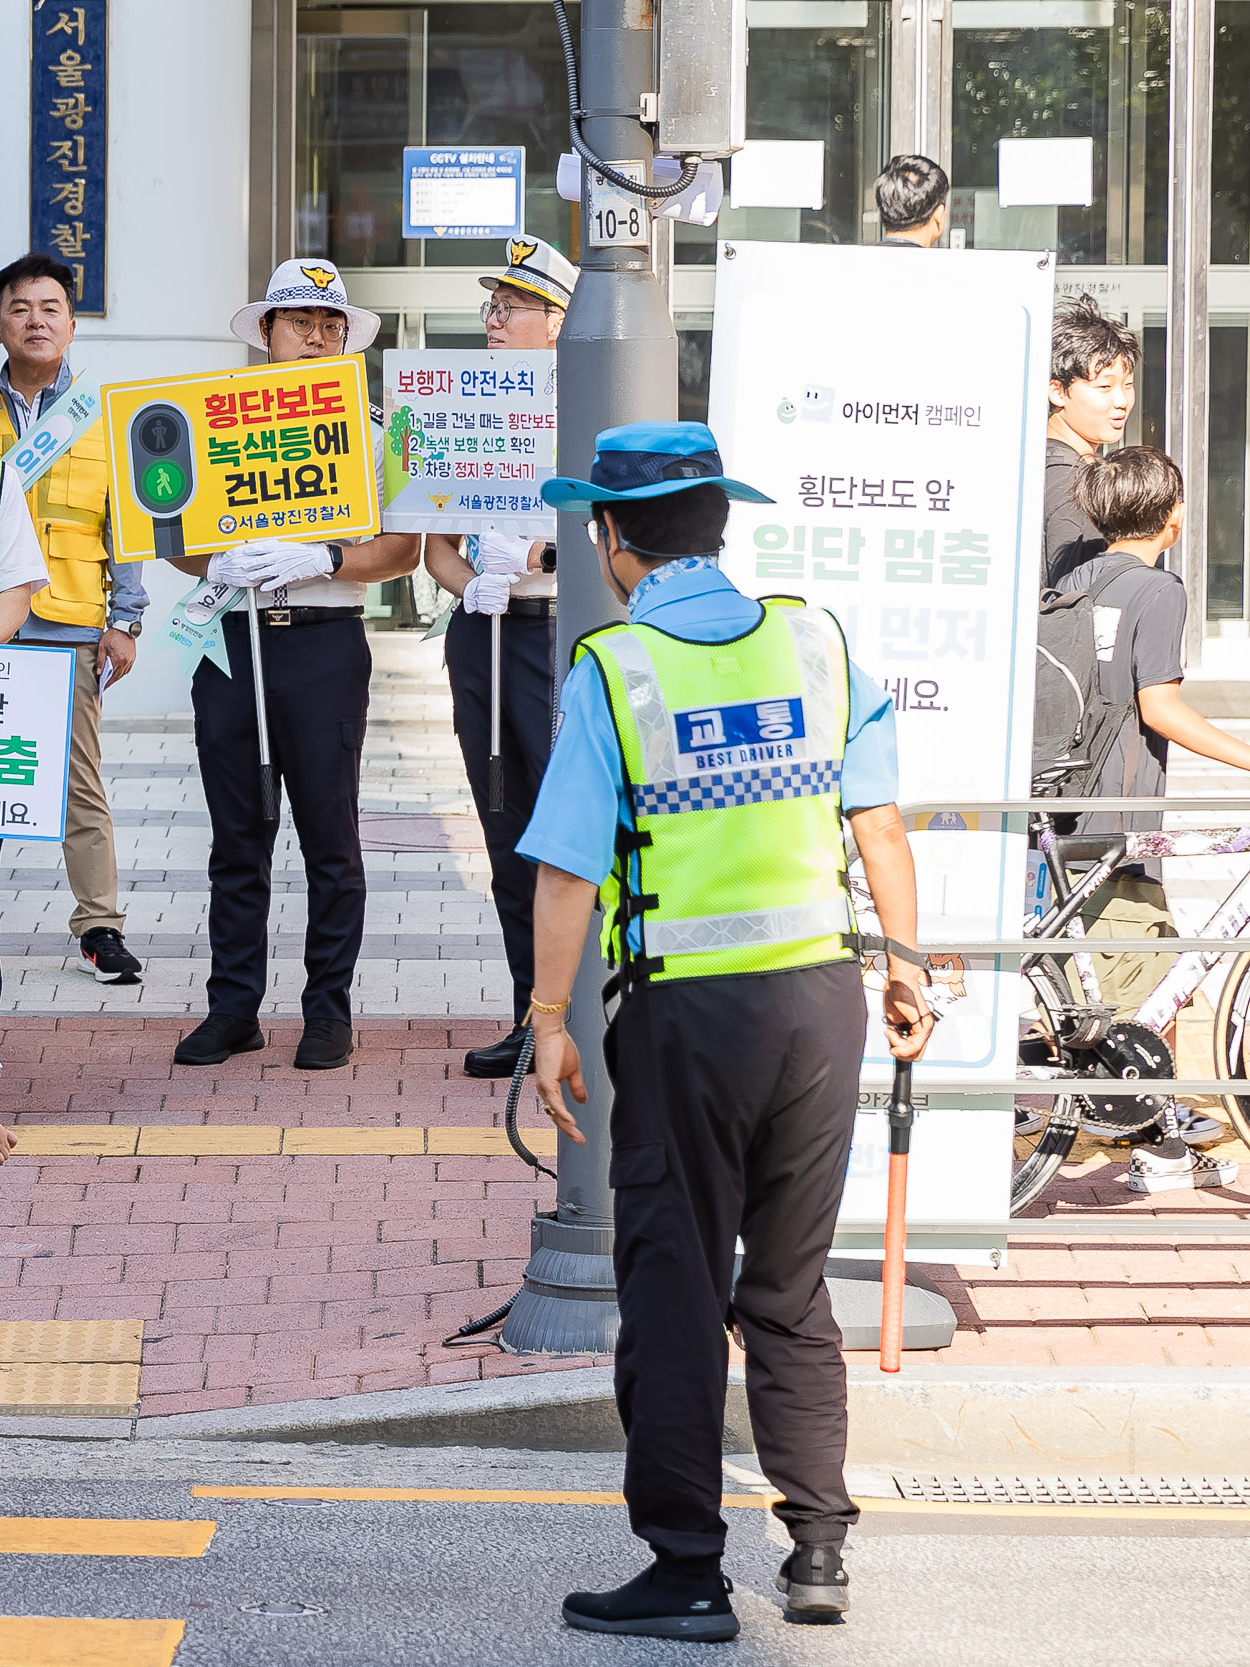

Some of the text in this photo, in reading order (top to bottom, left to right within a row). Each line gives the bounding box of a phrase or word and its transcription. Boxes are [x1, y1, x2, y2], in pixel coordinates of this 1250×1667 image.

[430, 152, 457, 165] CCTV
[595, 208, 640, 239] 10-8
[398, 369, 534, 397] 보행자 안전수칙
[204, 380, 346, 429] 횡단보도
[842, 401, 982, 428] 아이먼저 캠페인
[410, 412, 557, 430] 1. 길을 건널 때는 횡단보도
[15, 431, 59, 475] 아이
[207, 420, 350, 468] 녹색등에
[410, 436, 535, 454] 2. 녹색 보행 신호 확인
[410, 461, 535, 480] 3. 차량 정지 후 건너기
[224, 462, 338, 508] 건너요!
[798, 474, 955, 512] 횡단보도 앞
[458, 494, 544, 511] 서울광진경찰서
[238, 503, 351, 530] 서울광진경찰서
[753, 523, 992, 586] 일단 멈춤
[197, 583, 230, 609] 세요
[695, 744, 793, 769] BEST DRIVER
